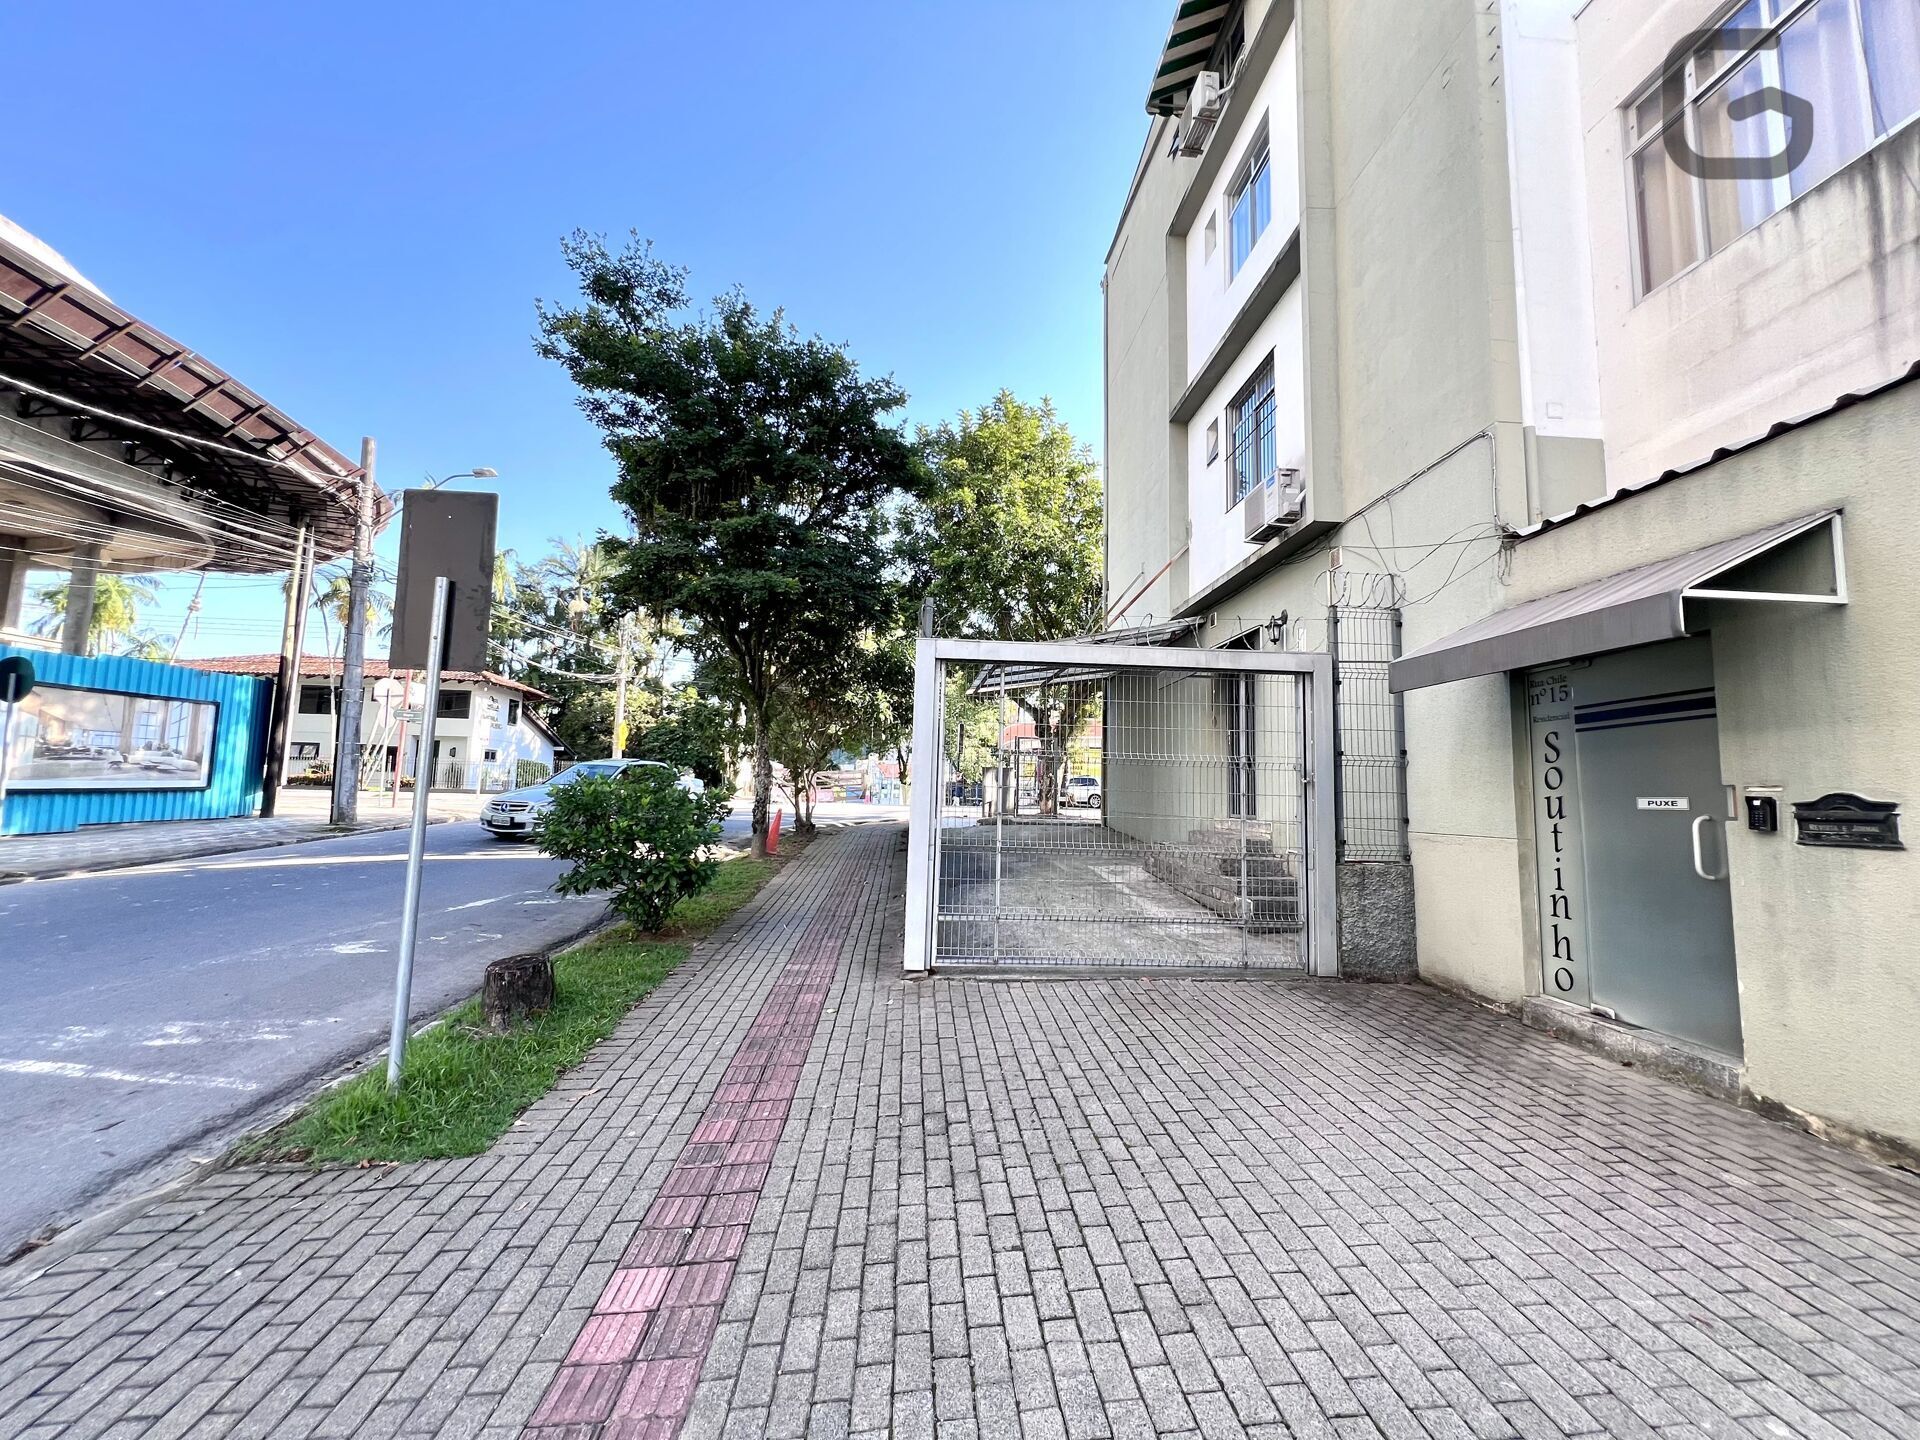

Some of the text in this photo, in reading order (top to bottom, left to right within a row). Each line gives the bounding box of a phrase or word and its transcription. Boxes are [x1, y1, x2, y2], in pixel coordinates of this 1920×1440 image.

[1530, 674, 1568, 688] Rua Chile
[1544, 731, 1574, 992] Soutinho
